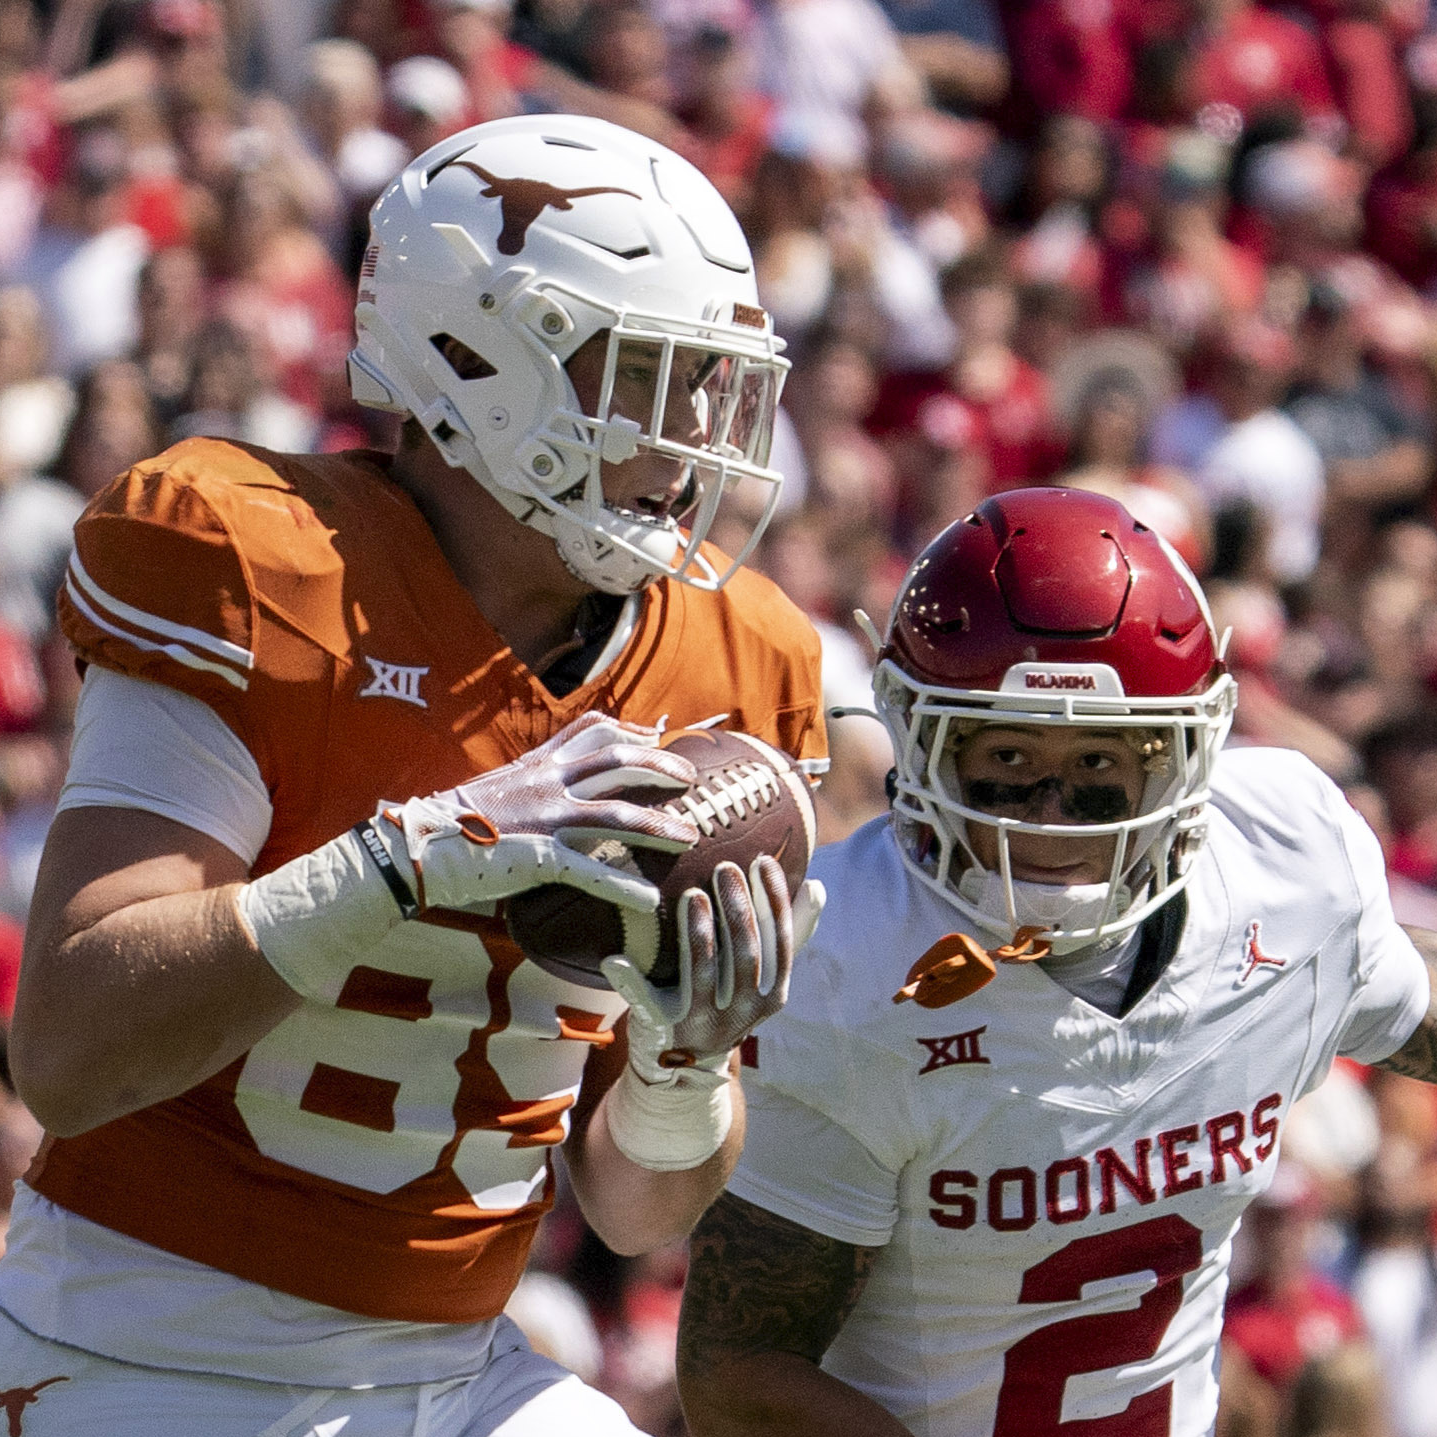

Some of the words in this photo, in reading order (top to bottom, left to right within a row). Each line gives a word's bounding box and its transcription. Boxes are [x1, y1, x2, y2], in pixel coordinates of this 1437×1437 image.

[360, 656, 430, 708] XII
[1025, 674, 1096, 690] OKLAHOMA
[362, 828, 392, 867] #FAFO
[235, 918, 631, 1210] 89
[916, 1025, 991, 1075] XII
[929, 1092, 1283, 1232] SOONERS
